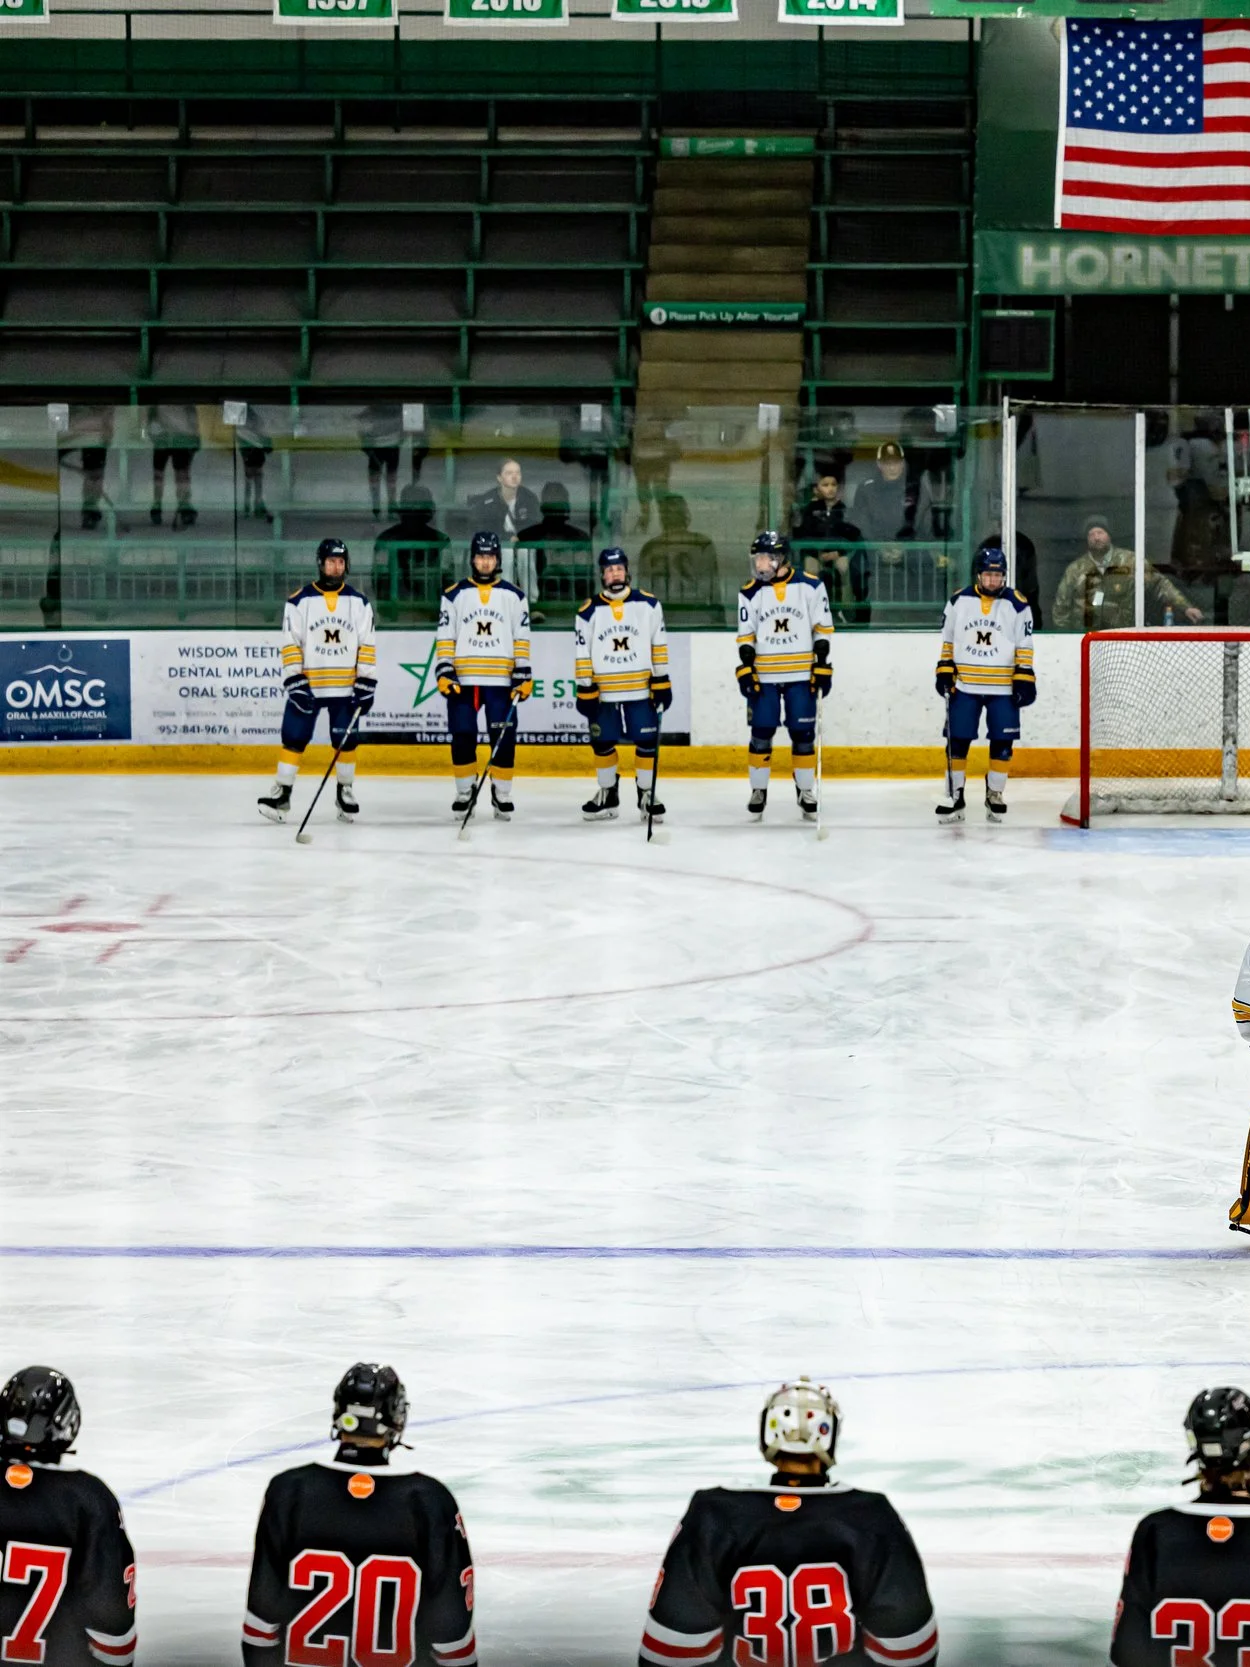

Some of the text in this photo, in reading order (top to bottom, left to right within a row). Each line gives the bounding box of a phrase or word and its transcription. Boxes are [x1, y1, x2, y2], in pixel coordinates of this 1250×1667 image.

[720, 311, 734, 323] Up
[178, 647, 238, 659] WISDOM
[168, 667, 282, 678] DENTAL IMPLAN
[5, 679, 106, 709] OMSC
[178, 687, 289, 699] ORAL SURGERY
[0, 1540, 73, 1665] 7
[285, 1548, 423, 1667] 20
[731, 1562, 859, 1667] 38
